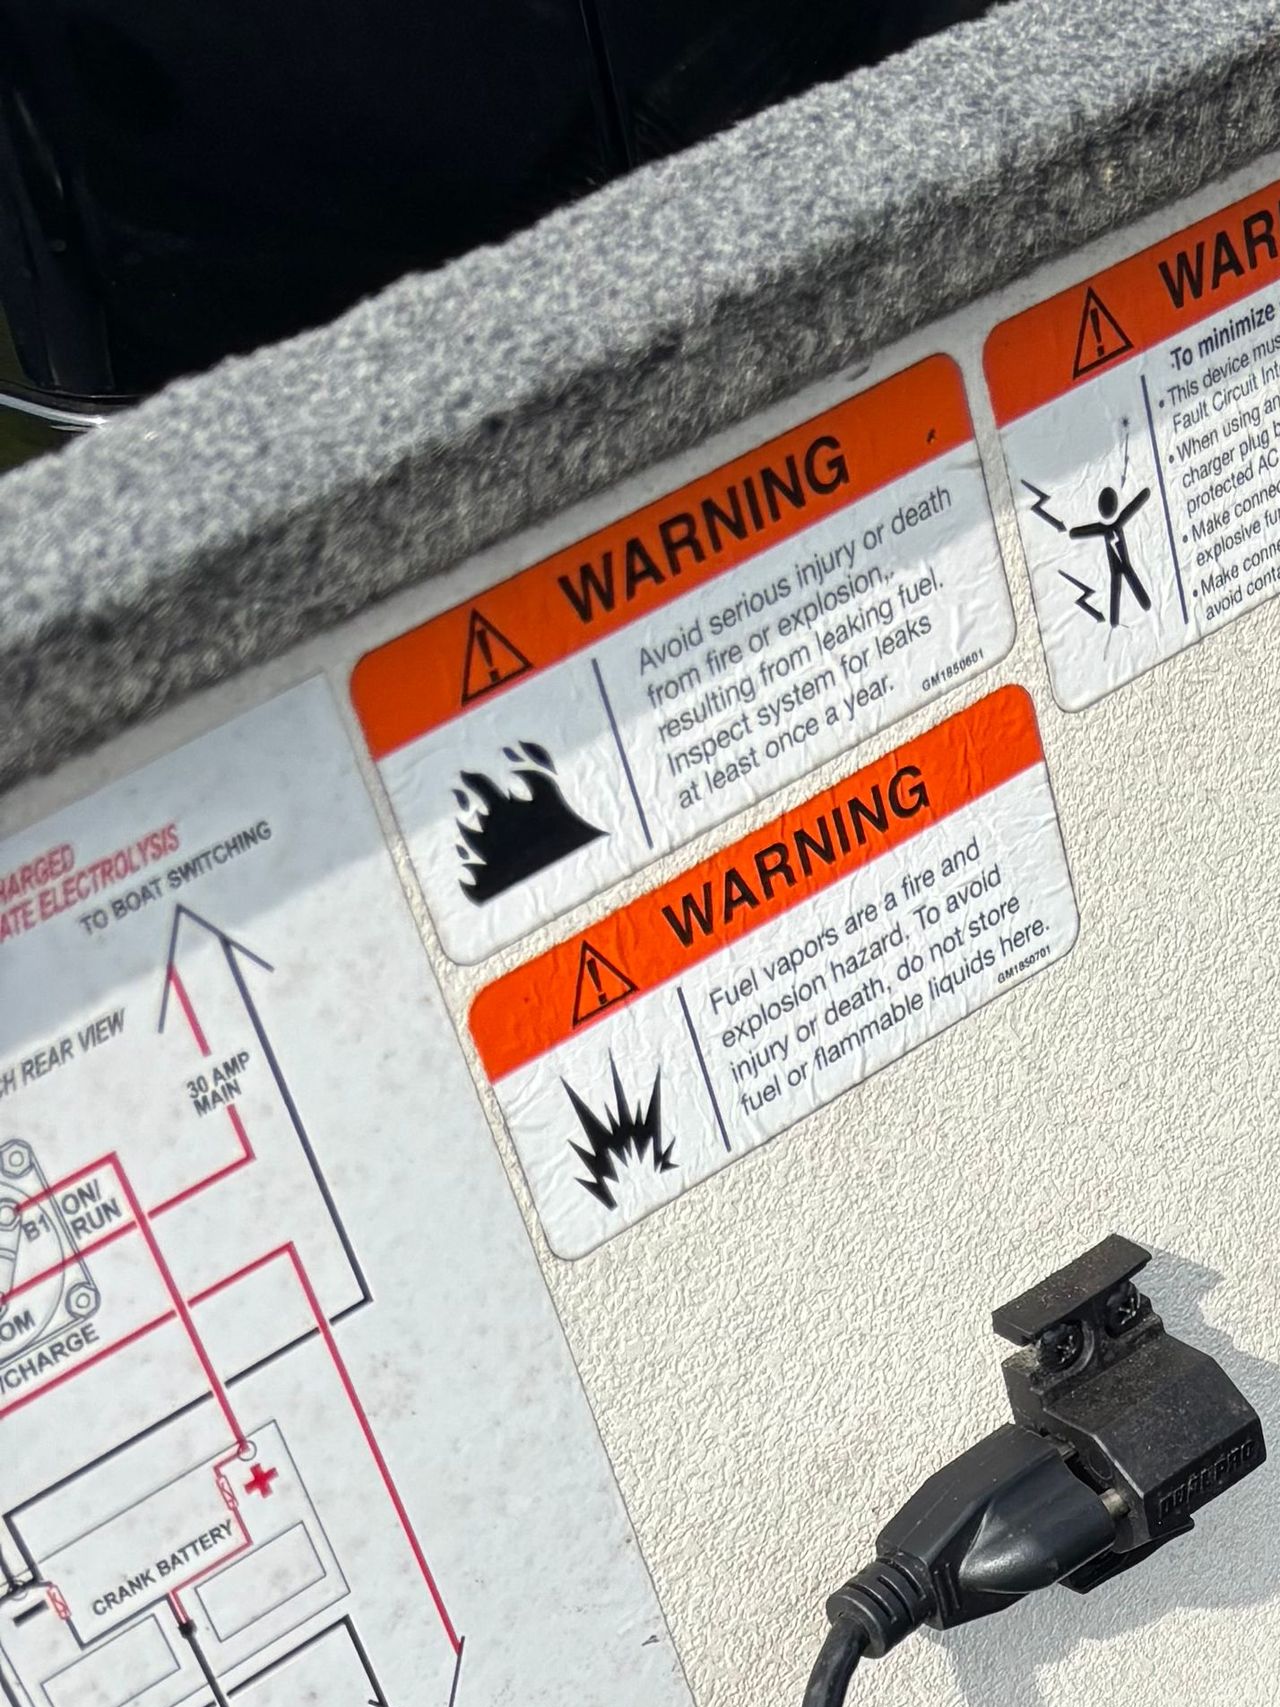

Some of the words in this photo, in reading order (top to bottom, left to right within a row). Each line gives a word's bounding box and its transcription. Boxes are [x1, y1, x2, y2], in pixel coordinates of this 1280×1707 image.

[1170, 345, 1193, 370] To
[1197, 303, 1275, 357] minimize
[560, 436, 847, 619] WARNING
[639, 619, 703, 674] Avoid
[708, 577, 791, 635] serious
[794, 540, 855, 587] injury
[862, 523, 884, 550] or
[890, 486, 951, 534] death
[646, 666, 701, 707] from
[705, 643, 742, 674] fire
[747, 625, 769, 652] or
[658, 676, 756, 742] resulting
[758, 644, 810, 685] from
[814, 598, 893, 653] leaking
[897, 566, 943, 608] fuel.
[666, 713, 751, 775] Inspect
[756, 669, 835, 726] system
[839, 647, 869, 679] for
[874, 615, 931, 658] leaks
[678, 780, 701, 809] at
[704, 747, 759, 792] least
[765, 716, 819, 758] once
[824, 705, 839, 726] a
[843, 674, 893, 720] year.
[79, 908, 108, 933] TO
[110, 877, 161, 918] BOAT
[167, 821, 270, 887] SWITCHING
[664, 766, 927, 943] WARNING
[708, 968, 758, 1014] Fuel
[762, 927, 838, 980] vapors
[844, 903, 878, 935] are
[883, 891, 898, 911] a
[900, 868, 935, 899] fire
[940, 835, 980, 877] and
[721, 974, 826, 1047] explosion
[829, 921, 909, 982] hazard.
[912, 904, 940, 930] To
[945, 863, 1001, 913] avoid
[730, 1034, 788, 1083] injury
[795, 1016, 817, 1042] or
[823, 977, 891, 1025] death,
[896, 954, 924, 981] do
[928, 926, 964, 962] not
[968, 896, 1019, 938] store
[20, 1038, 72, 1082] REAR
[77, 1008, 124, 1050] VIEW
[186, 1075, 208, 1099] 30
[212, 1051, 249, 1086] AMP
[740, 1074, 781, 1115] fuel
[786, 1061, 807, 1087] or
[814, 993, 923, 1069] flammable
[927, 948, 995, 1000] liquids
[998, 919, 1049, 956] here.
[193, 1079, 240, 1115] MAIN
[61, 1179, 100, 1214] ON/
[70, 1198, 120, 1238] RUN
[92, 1569, 155, 1615] CRANK
[155, 1519, 231, 1576] BATTERY
